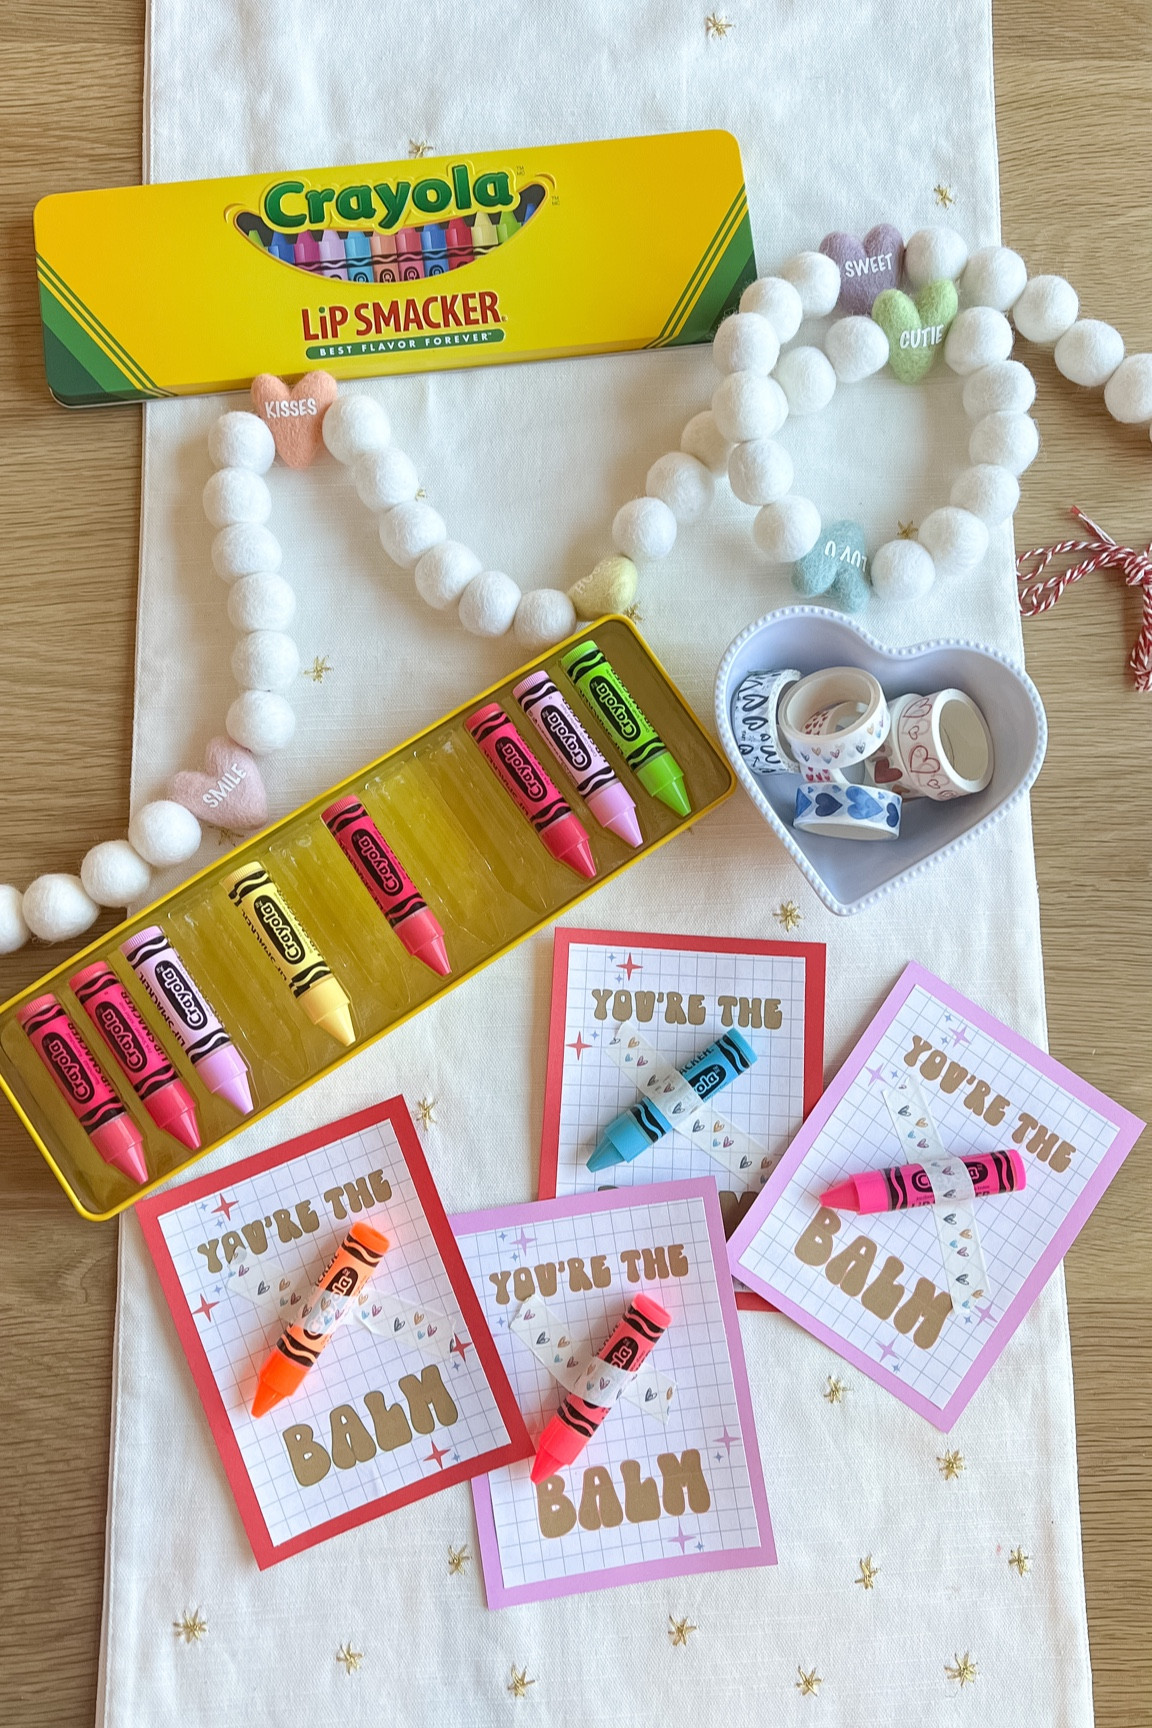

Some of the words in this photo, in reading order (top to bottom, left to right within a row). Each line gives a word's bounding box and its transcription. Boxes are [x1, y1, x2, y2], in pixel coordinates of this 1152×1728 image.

[264, 164, 514, 229] Crayola
[845, 252, 893, 279] SWEET
[319, 345, 352, 357] BEST
[361, 338, 416, 352] FLAVOR
[900, 324, 945, 349] CUTIE
[265, 398, 317, 418] KISSES
[825, 540, 836, 555] U
[841, 550, 867, 573] LUV
[598, 682, 636, 738] Crayola
[548, 712, 587, 770] Crayola
[203, 762, 248, 808] SMILE
[502, 743, 543, 799] Crayola
[358, 835, 400, 893] Crayola
[261, 903, 301, 961] Crayola
[161, 967, 203, 1027] Crayola
[592, 989, 706, 1025] YOU'RE
[718, 995, 783, 1030] THE
[102, 1008, 143, 1069] Crayola
[48, 1039, 89, 1101] Crayola
[903, 1035, 1010, 1127] YOU'RE
[1011, 1113, 1077, 1174] THE
[197, 1200, 321, 1274] YOU'RE
[323, 1169, 393, 1220] THE
[488, 1254, 612, 1305] YOU'RE
[620, 1244, 689, 1283] THE
[794, 1206, 953, 1350] BALM
[282, 1364, 459, 1486] BALM
[535, 1448, 712, 1539] BALM
